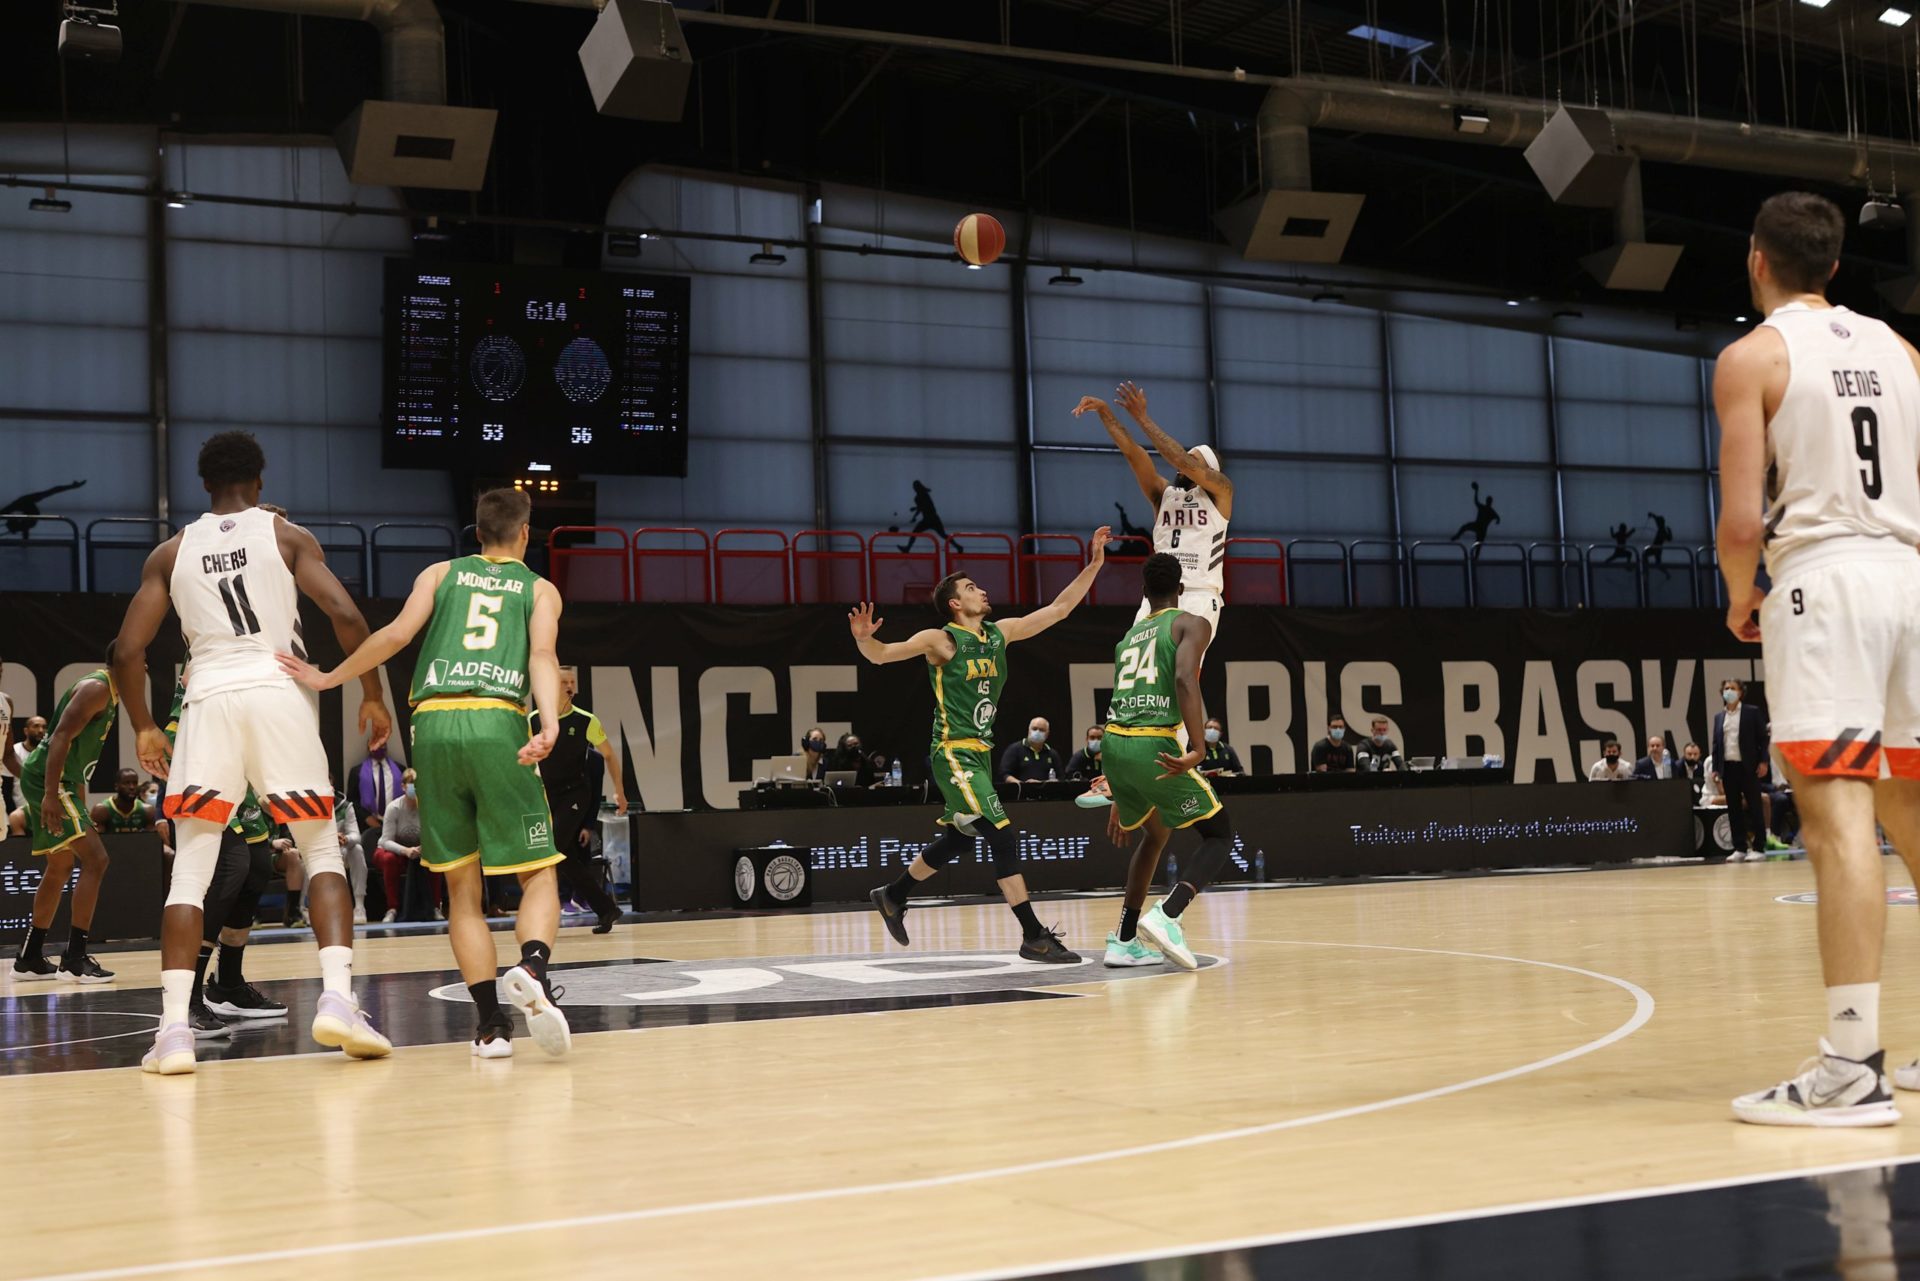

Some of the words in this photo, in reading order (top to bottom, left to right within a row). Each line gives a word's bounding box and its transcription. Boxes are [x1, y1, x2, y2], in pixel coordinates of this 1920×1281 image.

[526, 300, 568, 321] 6:14
[1832, 369, 1882, 398] DENIS
[482, 423, 504, 441] 53
[571, 426, 593, 444] 56
[1851, 406, 1883, 500] 9
[1162, 509, 1208, 526] ARIS
[1171, 529, 1181, 548] 6
[202, 548, 248, 574] CHERY
[456, 571, 524, 594] MONCLAR
[218, 574, 261, 636] 11
[1791, 588, 1805, 616] 9
[462, 592, 504, 650] 5
[449, 661, 525, 689] ADERIM
[1117, 637, 1159, 691] 24
[977, 680, 991, 695] 45
[1119, 694, 1170, 709] ADERIM
[1069, 660, 1405, 785] PRIS
[1441, 658, 1765, 784] BASKE
[1350, 824, 1416, 845] Traiteur
[1525, 821, 1541, 837] et
[1545, 816, 1639, 837] événements
[810, 836, 868, 870] and
